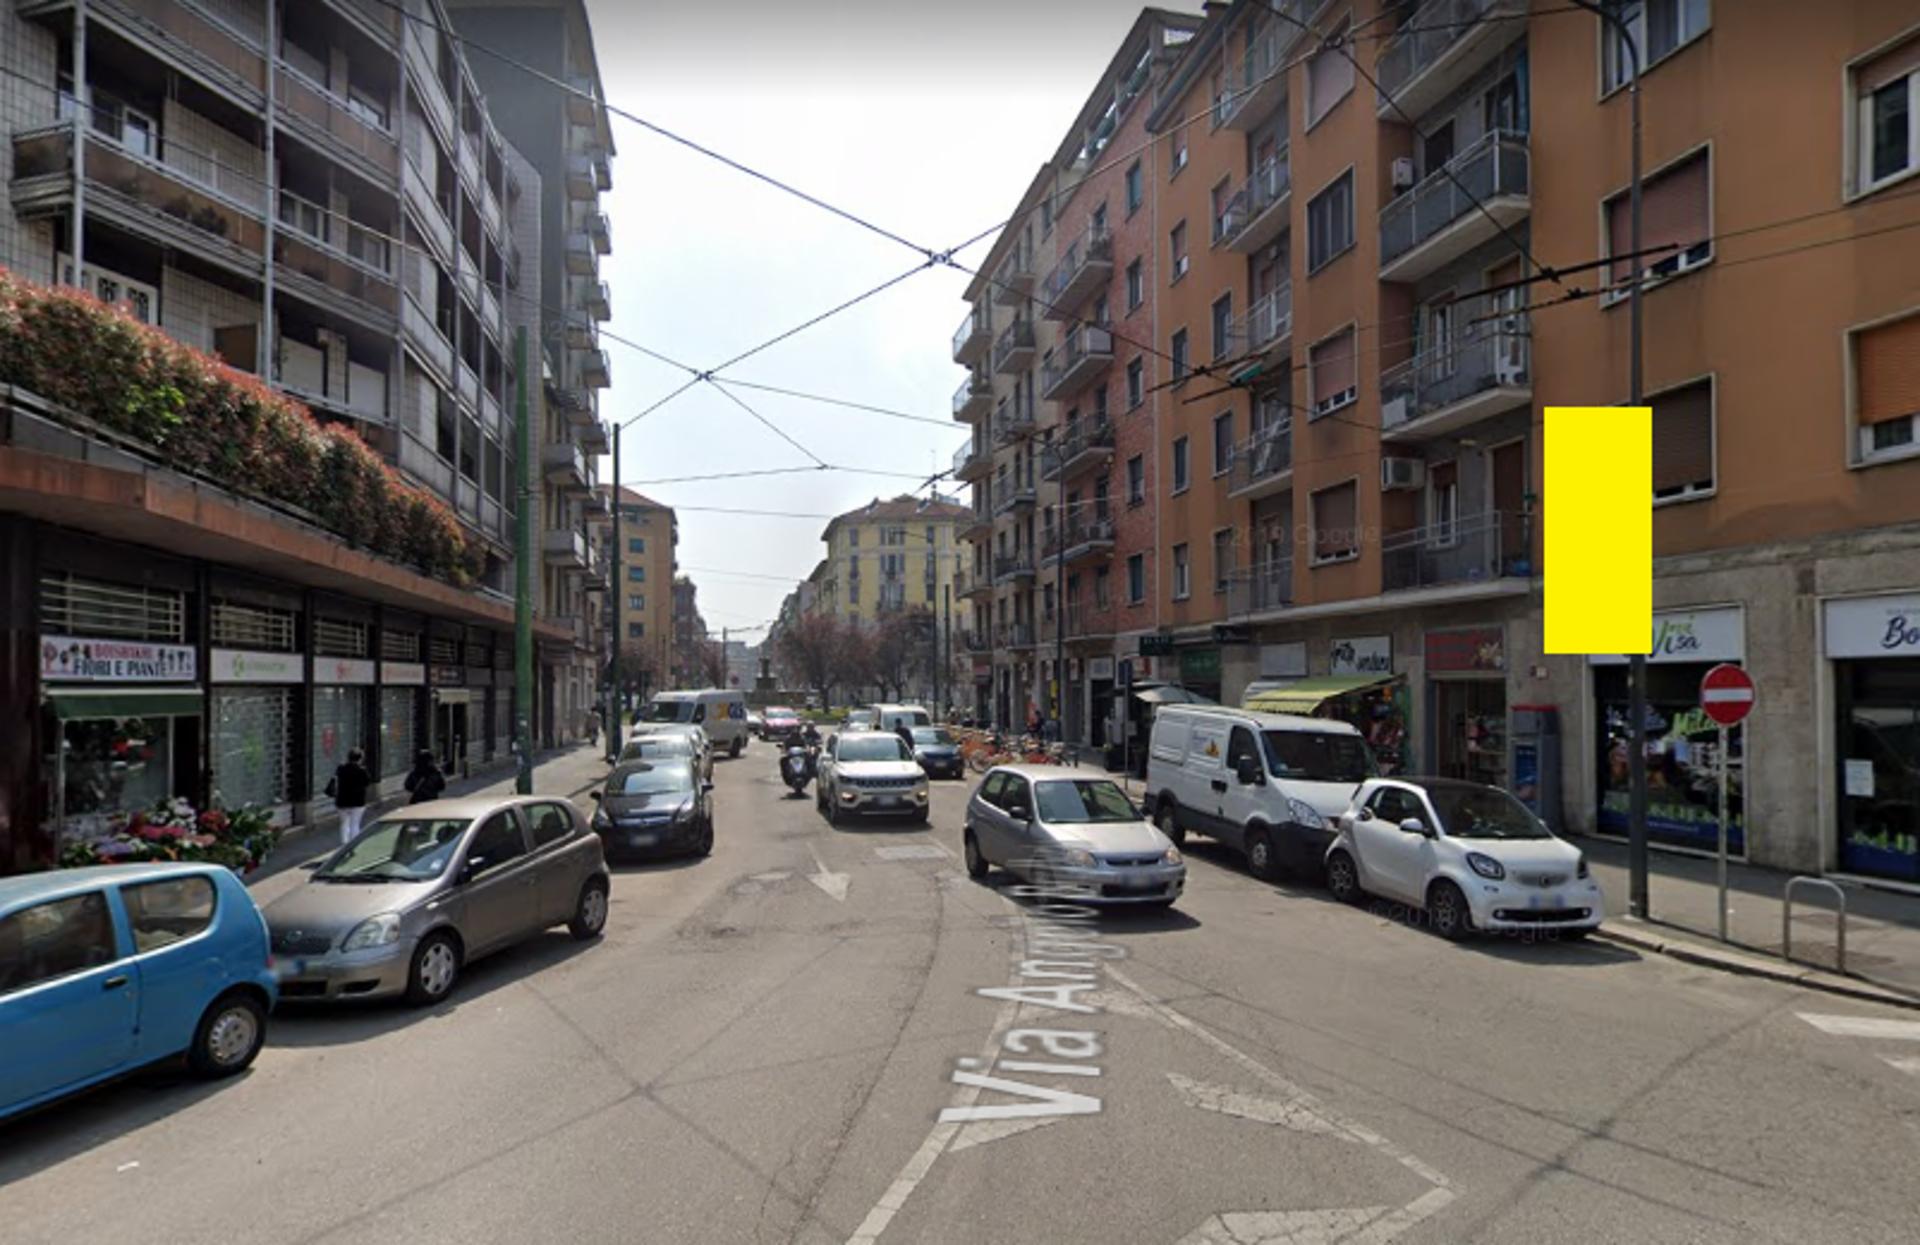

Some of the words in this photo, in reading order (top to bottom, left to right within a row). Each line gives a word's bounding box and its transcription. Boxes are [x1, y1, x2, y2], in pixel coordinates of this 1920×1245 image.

[73, 658, 111, 676] FIORI
[115, 659, 123, 676] E
[127, 660, 167, 677] PIANTE
